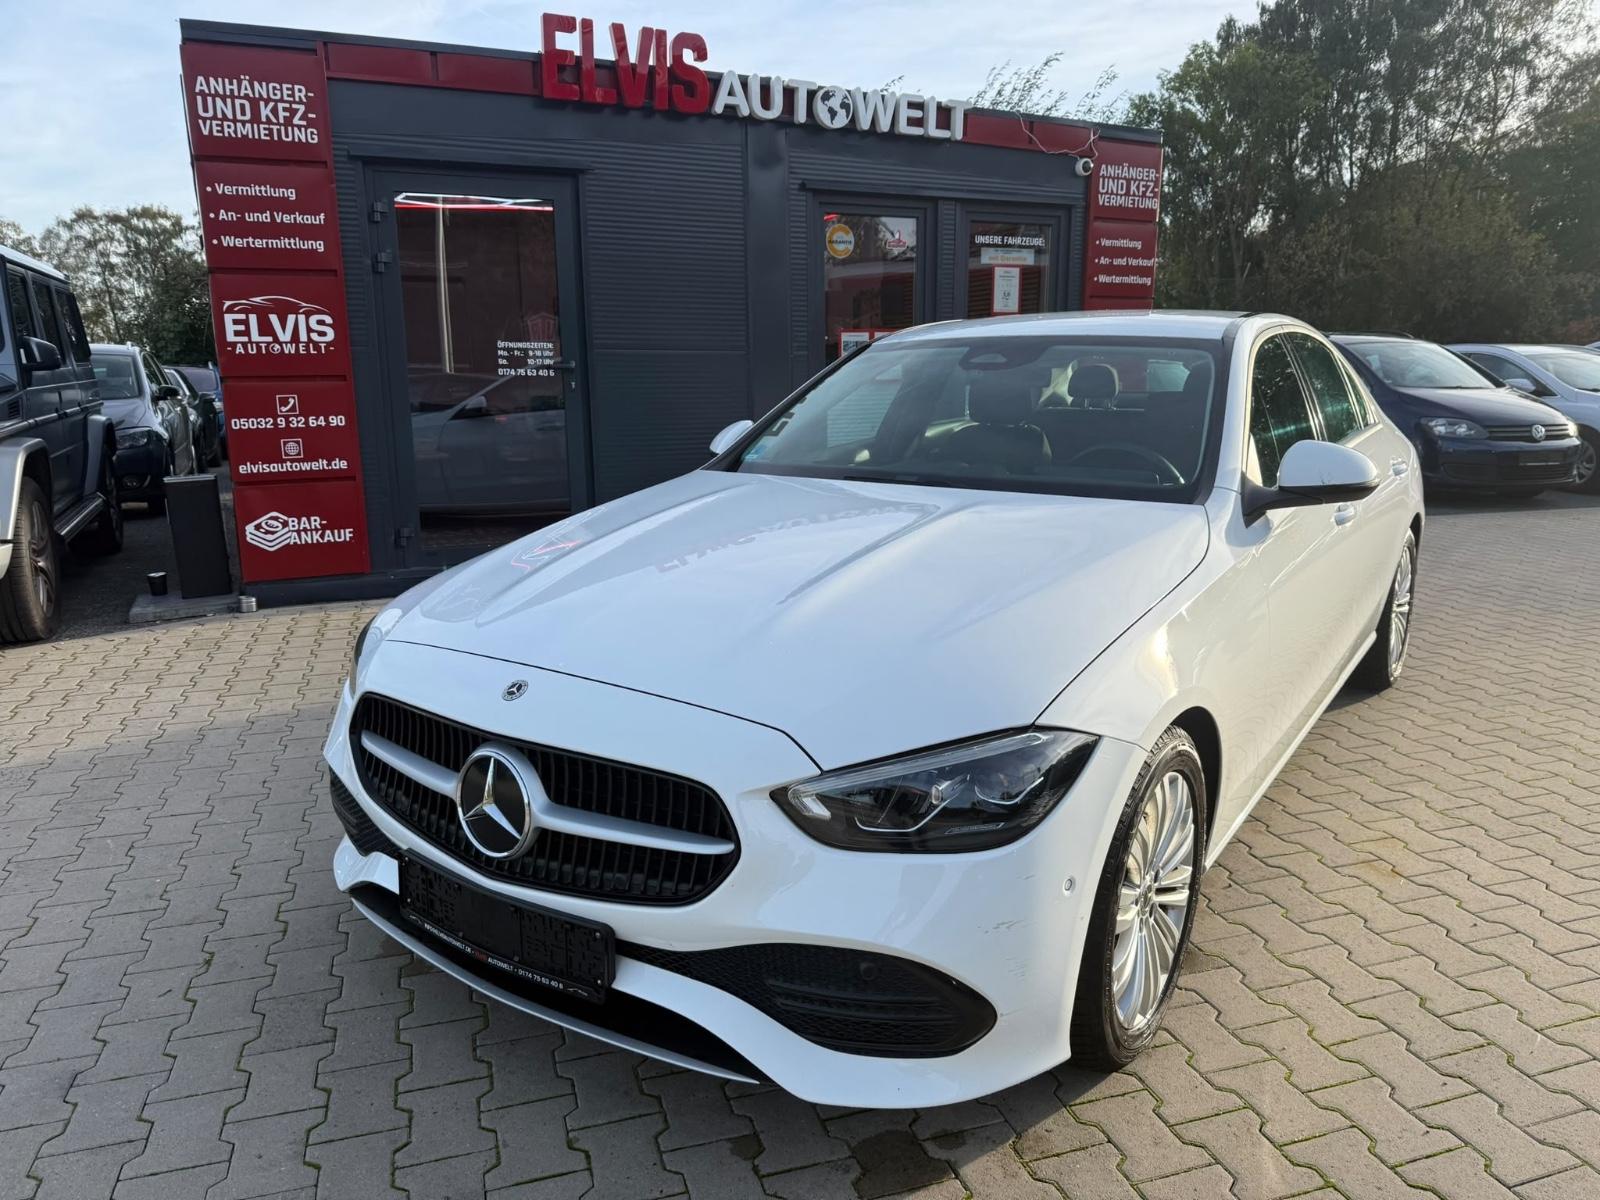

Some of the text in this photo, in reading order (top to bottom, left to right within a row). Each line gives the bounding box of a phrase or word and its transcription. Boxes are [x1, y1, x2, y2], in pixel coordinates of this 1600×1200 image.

[540, 12, 974, 142] ELVIS AUTOWELT
[195, 74, 315, 102] ANHÄNGER-
[196, 95, 316, 126] UND KFZ-
[198, 119, 319, 144] VERMIETUNG
[1100, 163, 1159, 181] ANHÄNGER-
[214, 182, 296, 200] Vermittlung
[1099, 178, 1159, 197] UND KFZ-
[1098, 194, 1158, 209] VERMIETUNG
[218, 209, 325, 225] An- und Verkauf
[221, 235, 325, 252] Wertermittlung
[975, 234, 1045, 246] UNSERE FAHRZEUGE:
[1100, 238, 1142, 250] Vermittlung
[1099, 256, 1155, 267] An- und Verkauf
[1099, 274, 1152, 285] Wertermittlung
[223, 313, 335, 342] ELVIS
[497, 340, 554, 349] ÖFFNUNGSZEITEN:
[231, 415, 346, 430] 05032 9 32 64 90
[239, 458, 348, 474] elvisautowelt.de
[288, 516, 327, 531] BAR-
[289, 528, 354, 546] ANKAUF
[518, 969, 532, 980] 0174
